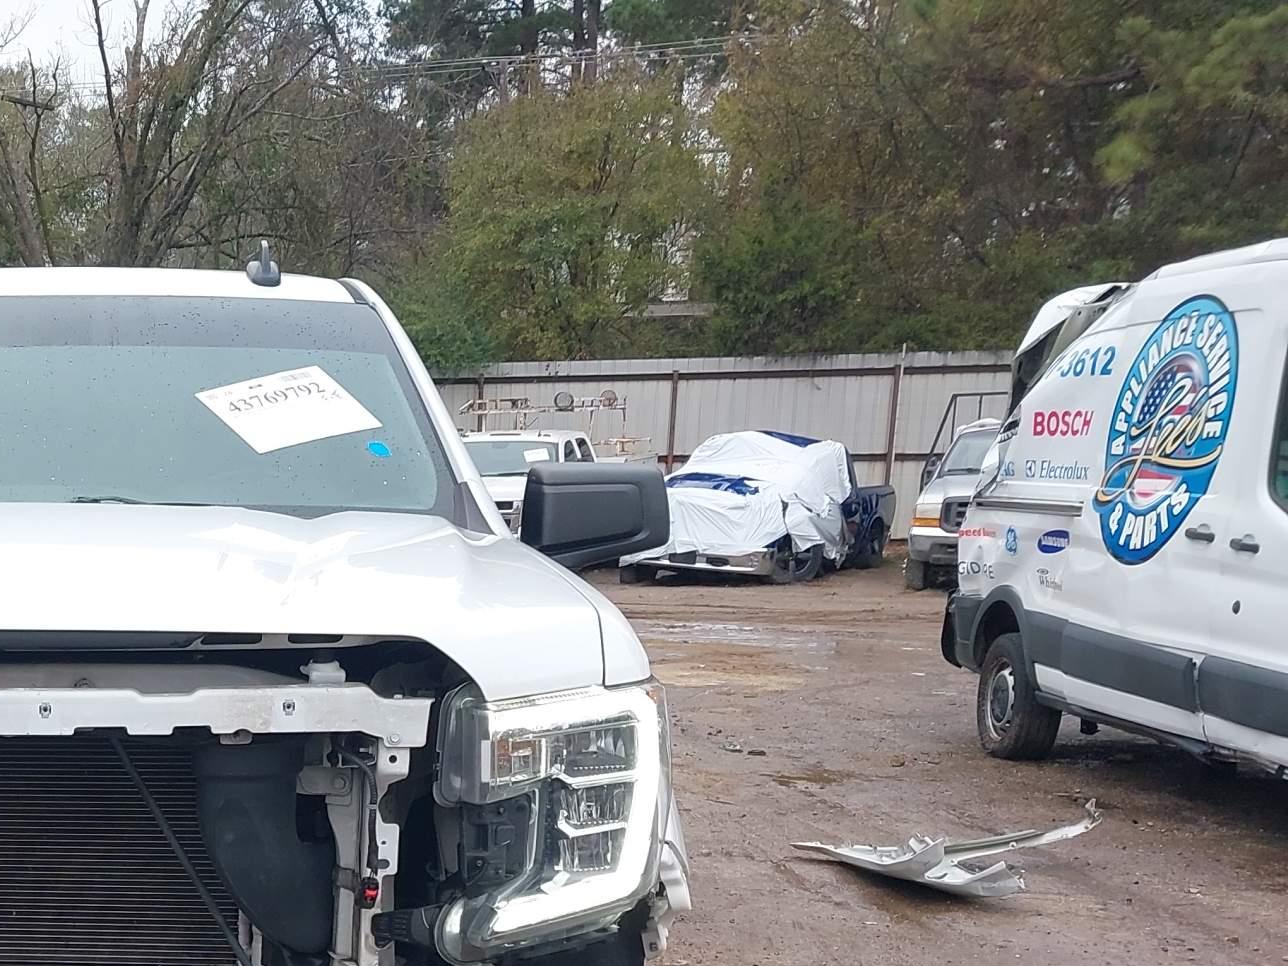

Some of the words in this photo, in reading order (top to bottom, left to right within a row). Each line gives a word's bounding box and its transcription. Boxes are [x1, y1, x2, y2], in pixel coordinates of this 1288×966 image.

[227, 381, 327, 413] 43769792
[1111, 310, 1200, 456] APPLIANCE
[1195, 313, 1231, 440] SERVICE
[1032, 410, 1094, 436] BOSCH
[1039, 460, 1089, 480] Electrolux
[1109, 502, 1123, 536] &
[1118, 483, 1191, 550] PARTS
